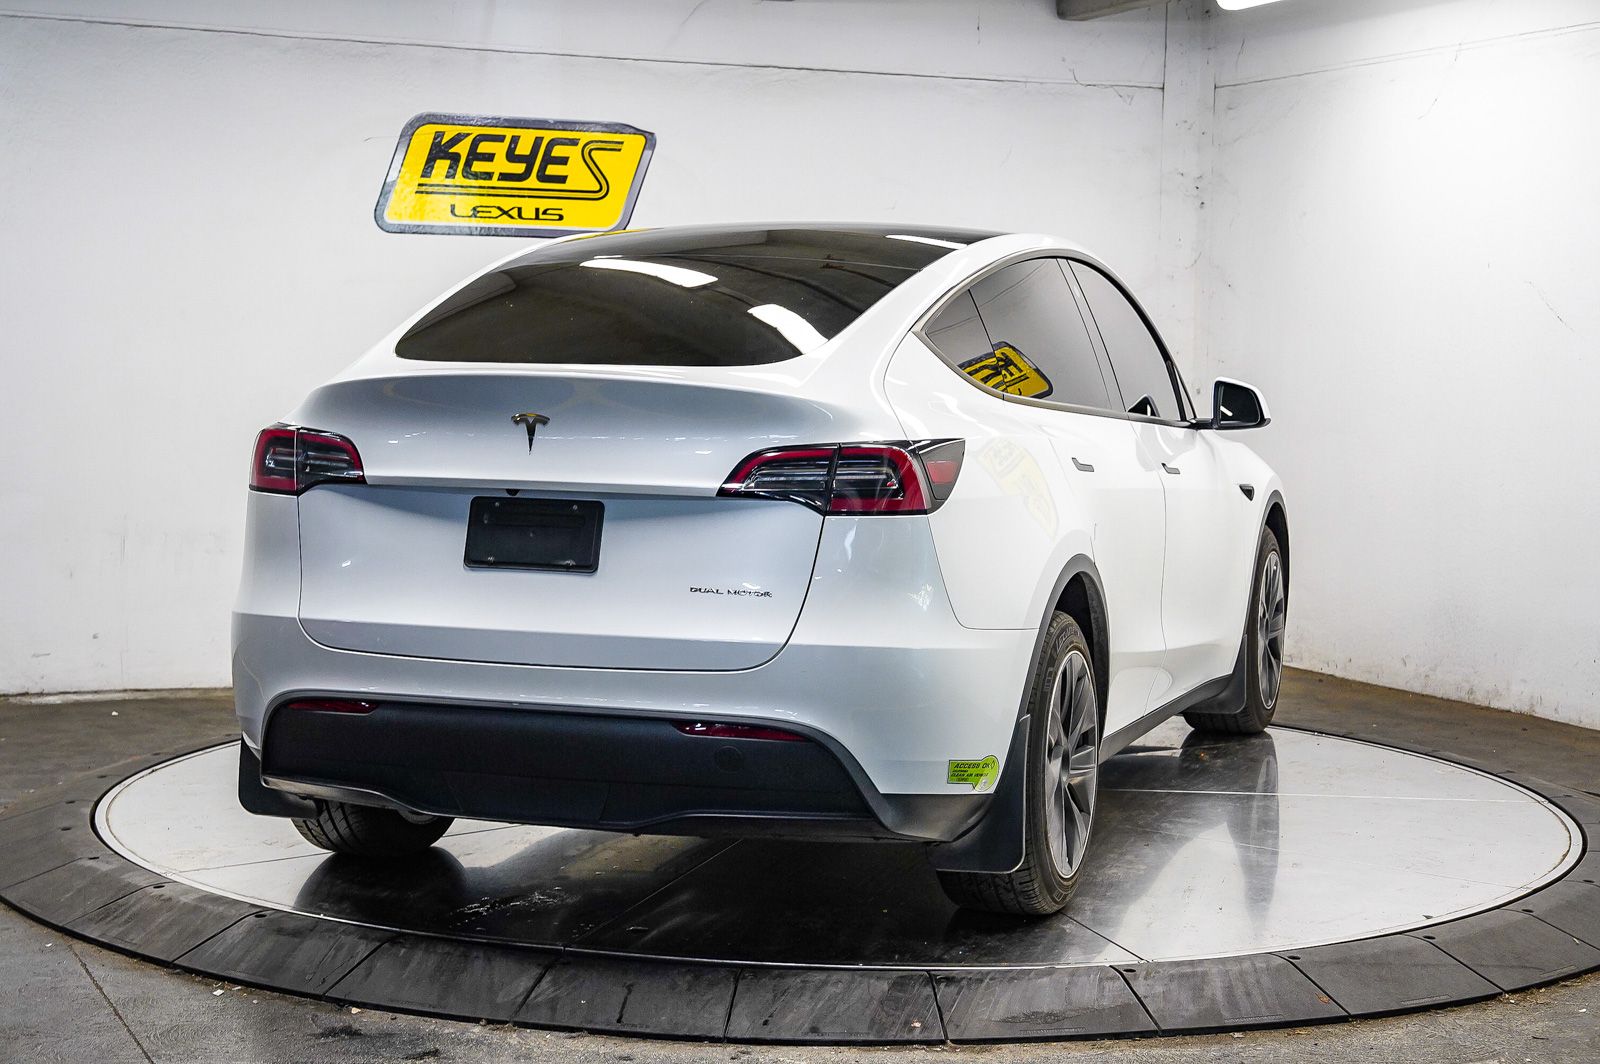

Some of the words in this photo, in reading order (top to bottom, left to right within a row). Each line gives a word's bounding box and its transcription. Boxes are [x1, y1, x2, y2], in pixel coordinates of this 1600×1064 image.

[415, 131, 625, 200] KEYES
[450, 204, 565, 222] LEXUS
[689, 587, 724, 595] DUAL
[727, 589, 773, 598] MOTOR
